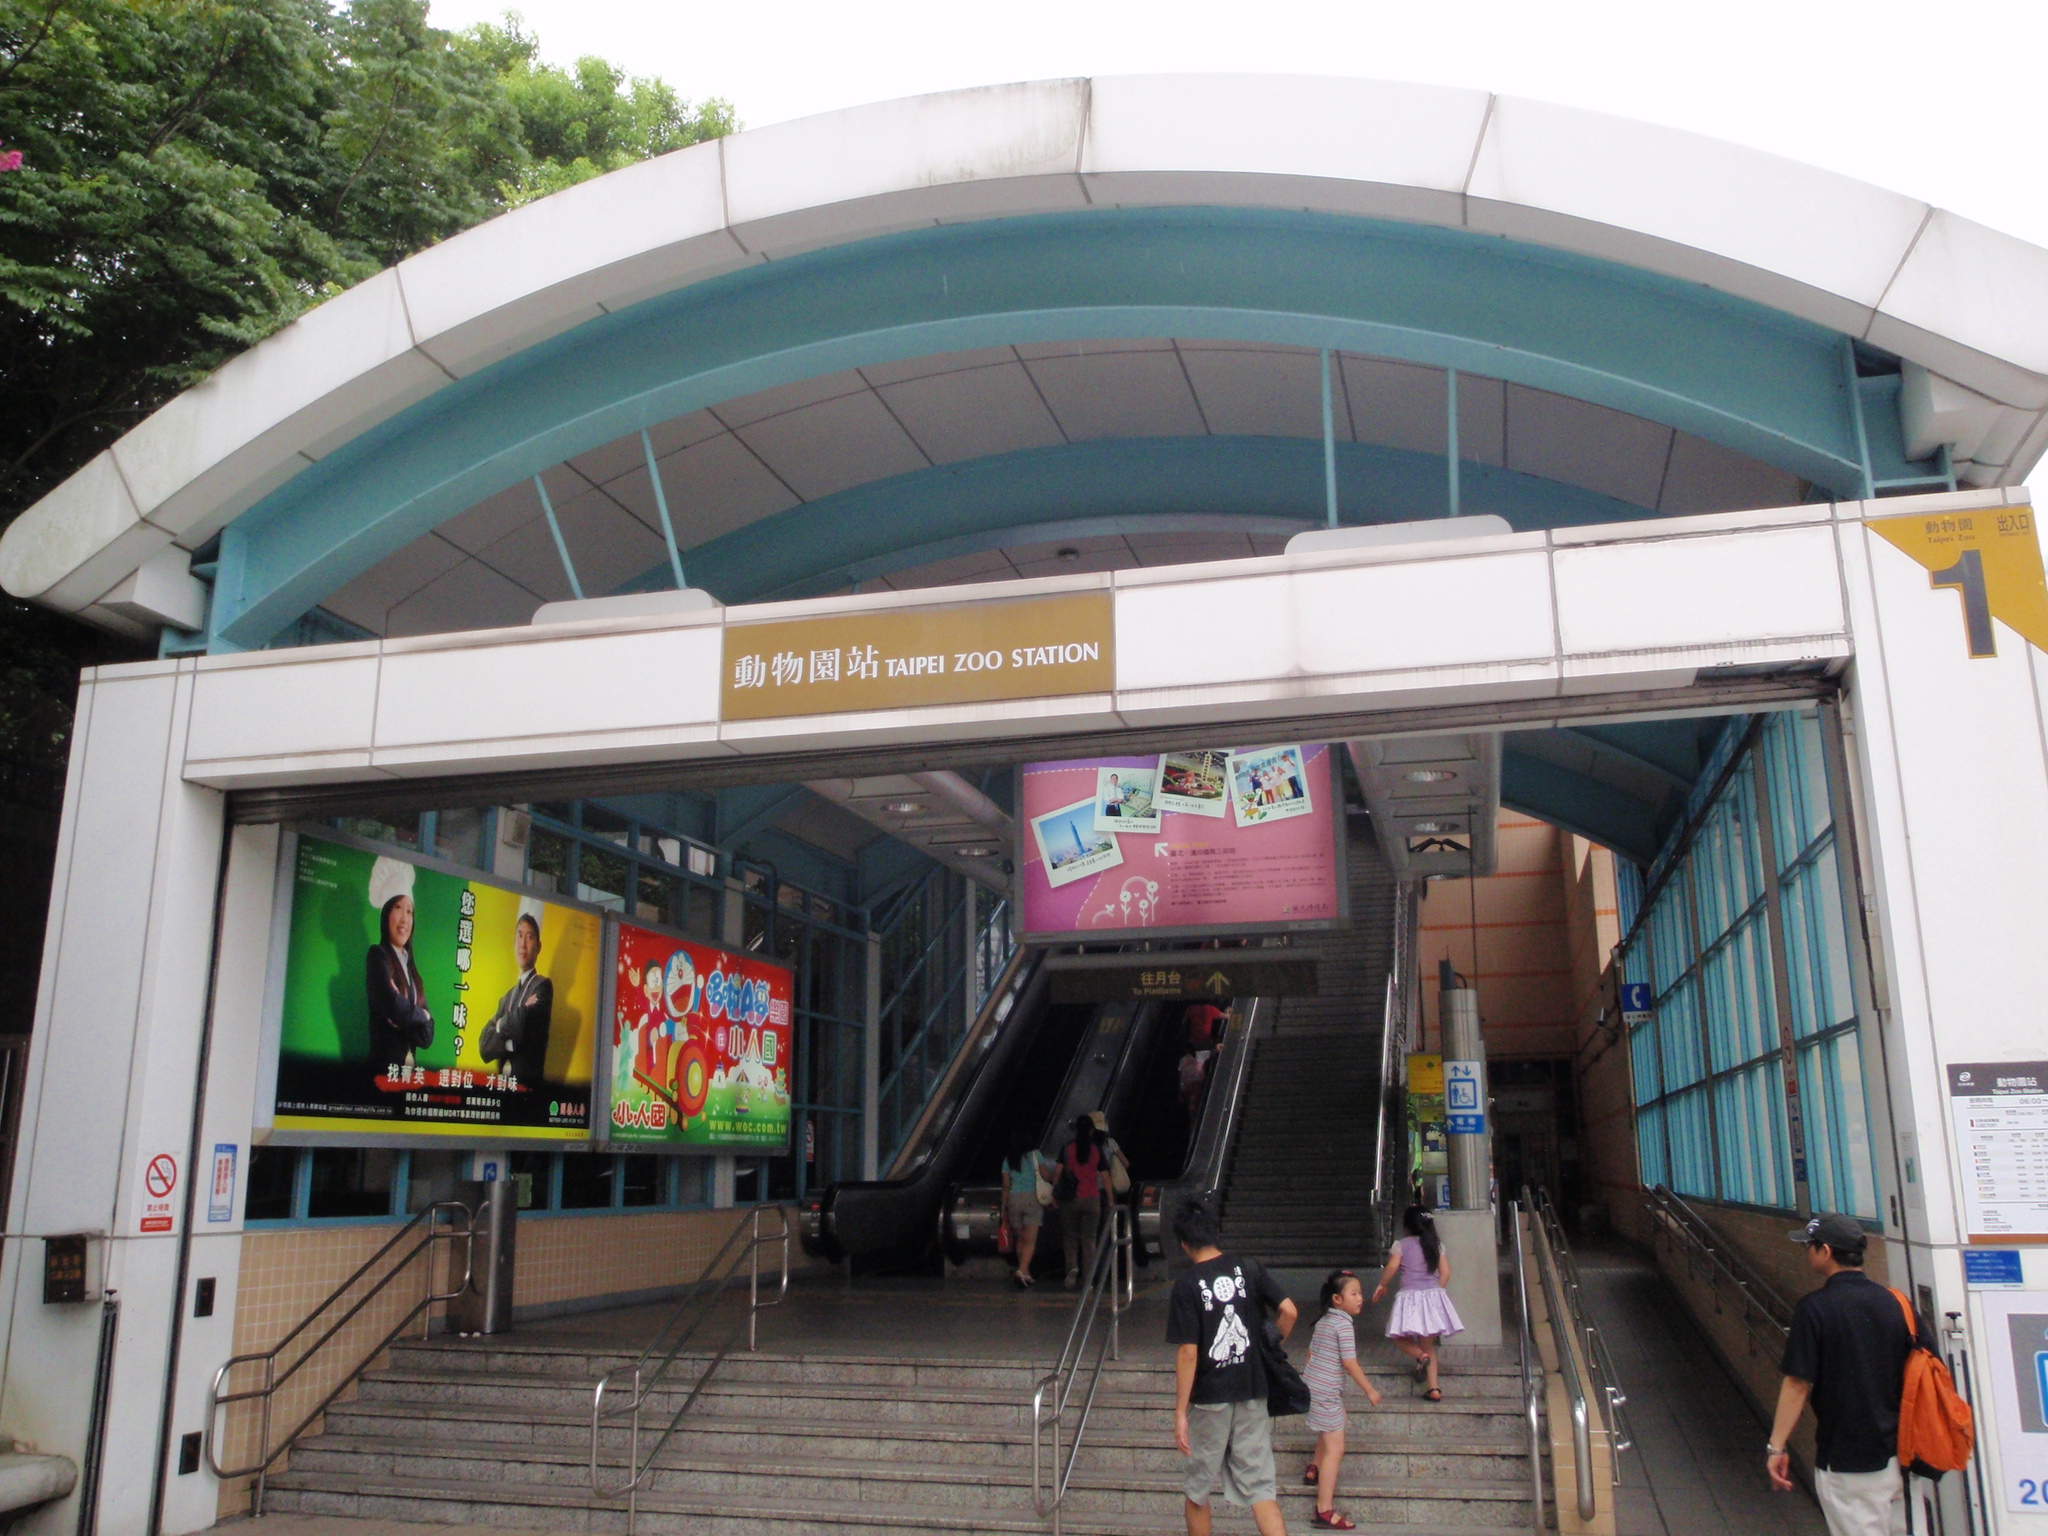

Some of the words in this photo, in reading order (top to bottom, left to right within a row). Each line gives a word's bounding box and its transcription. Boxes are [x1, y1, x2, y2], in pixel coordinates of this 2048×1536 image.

[1925, 518, 1973, 534] 動物園
[1997, 514, 2030, 532] 出入口
[1927, 535, 1954, 545] Taipei
[1957, 534, 1975, 542] Zoo
[1931, 548, 1997, 658] 1
[733, 644, 880, 690] 動物園站
[885, 655, 945, 678] TAIPEI
[954, 650, 1003, 673] ZOO
[1012, 642, 1099, 669] STATION
[1140, 970, 1181, 986] 往月台
[1132, 987, 1142, 995] To
[1144, 986, 1182, 996] Platforms
[728, 1025, 777, 1065] 小人國
[387, 1062, 425, 1085] 找菁英
[438, 1068, 474, 1090] 選對位
[486, 1073, 518, 1093] 才對味
[613, 1100, 667, 1130] 小人國
[709, 1118, 787, 1134] www.woc.com.tw
